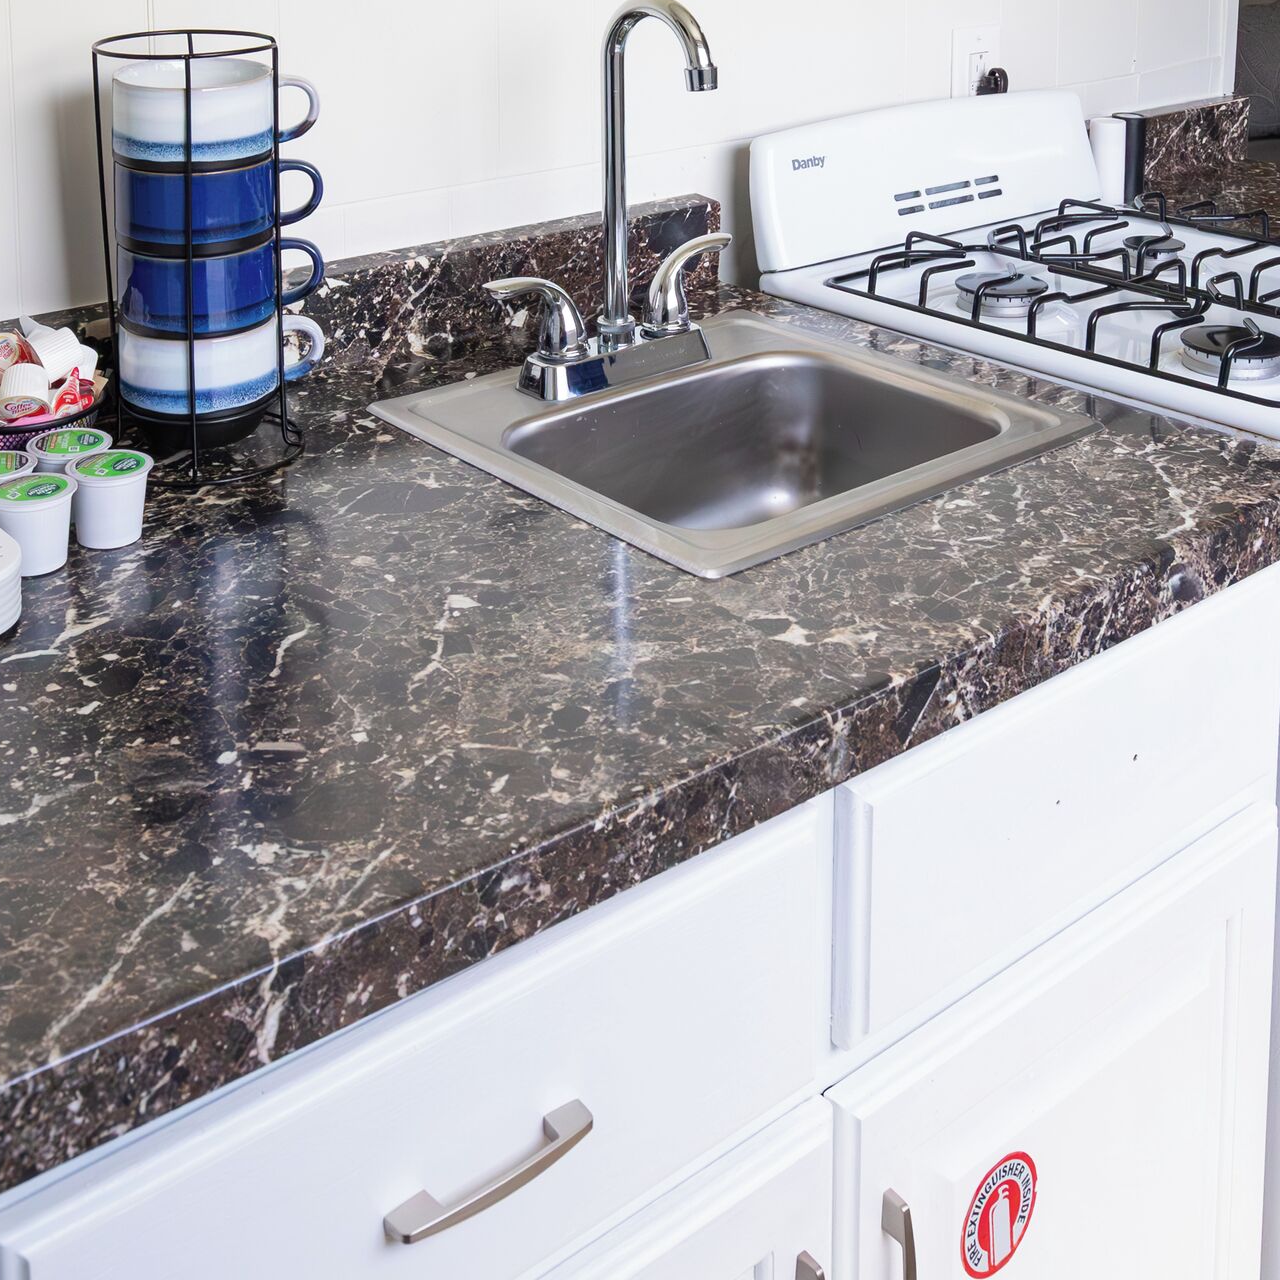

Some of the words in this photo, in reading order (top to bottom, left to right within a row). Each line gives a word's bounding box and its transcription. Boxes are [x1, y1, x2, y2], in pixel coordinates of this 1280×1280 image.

[791, 154, 826, 171] Danby
[966, 1162, 1026, 1239] EXTINGUISHER
[1017, 1173, 1031, 1224] INSIDE
[967, 1239, 983, 1267] FIRE
